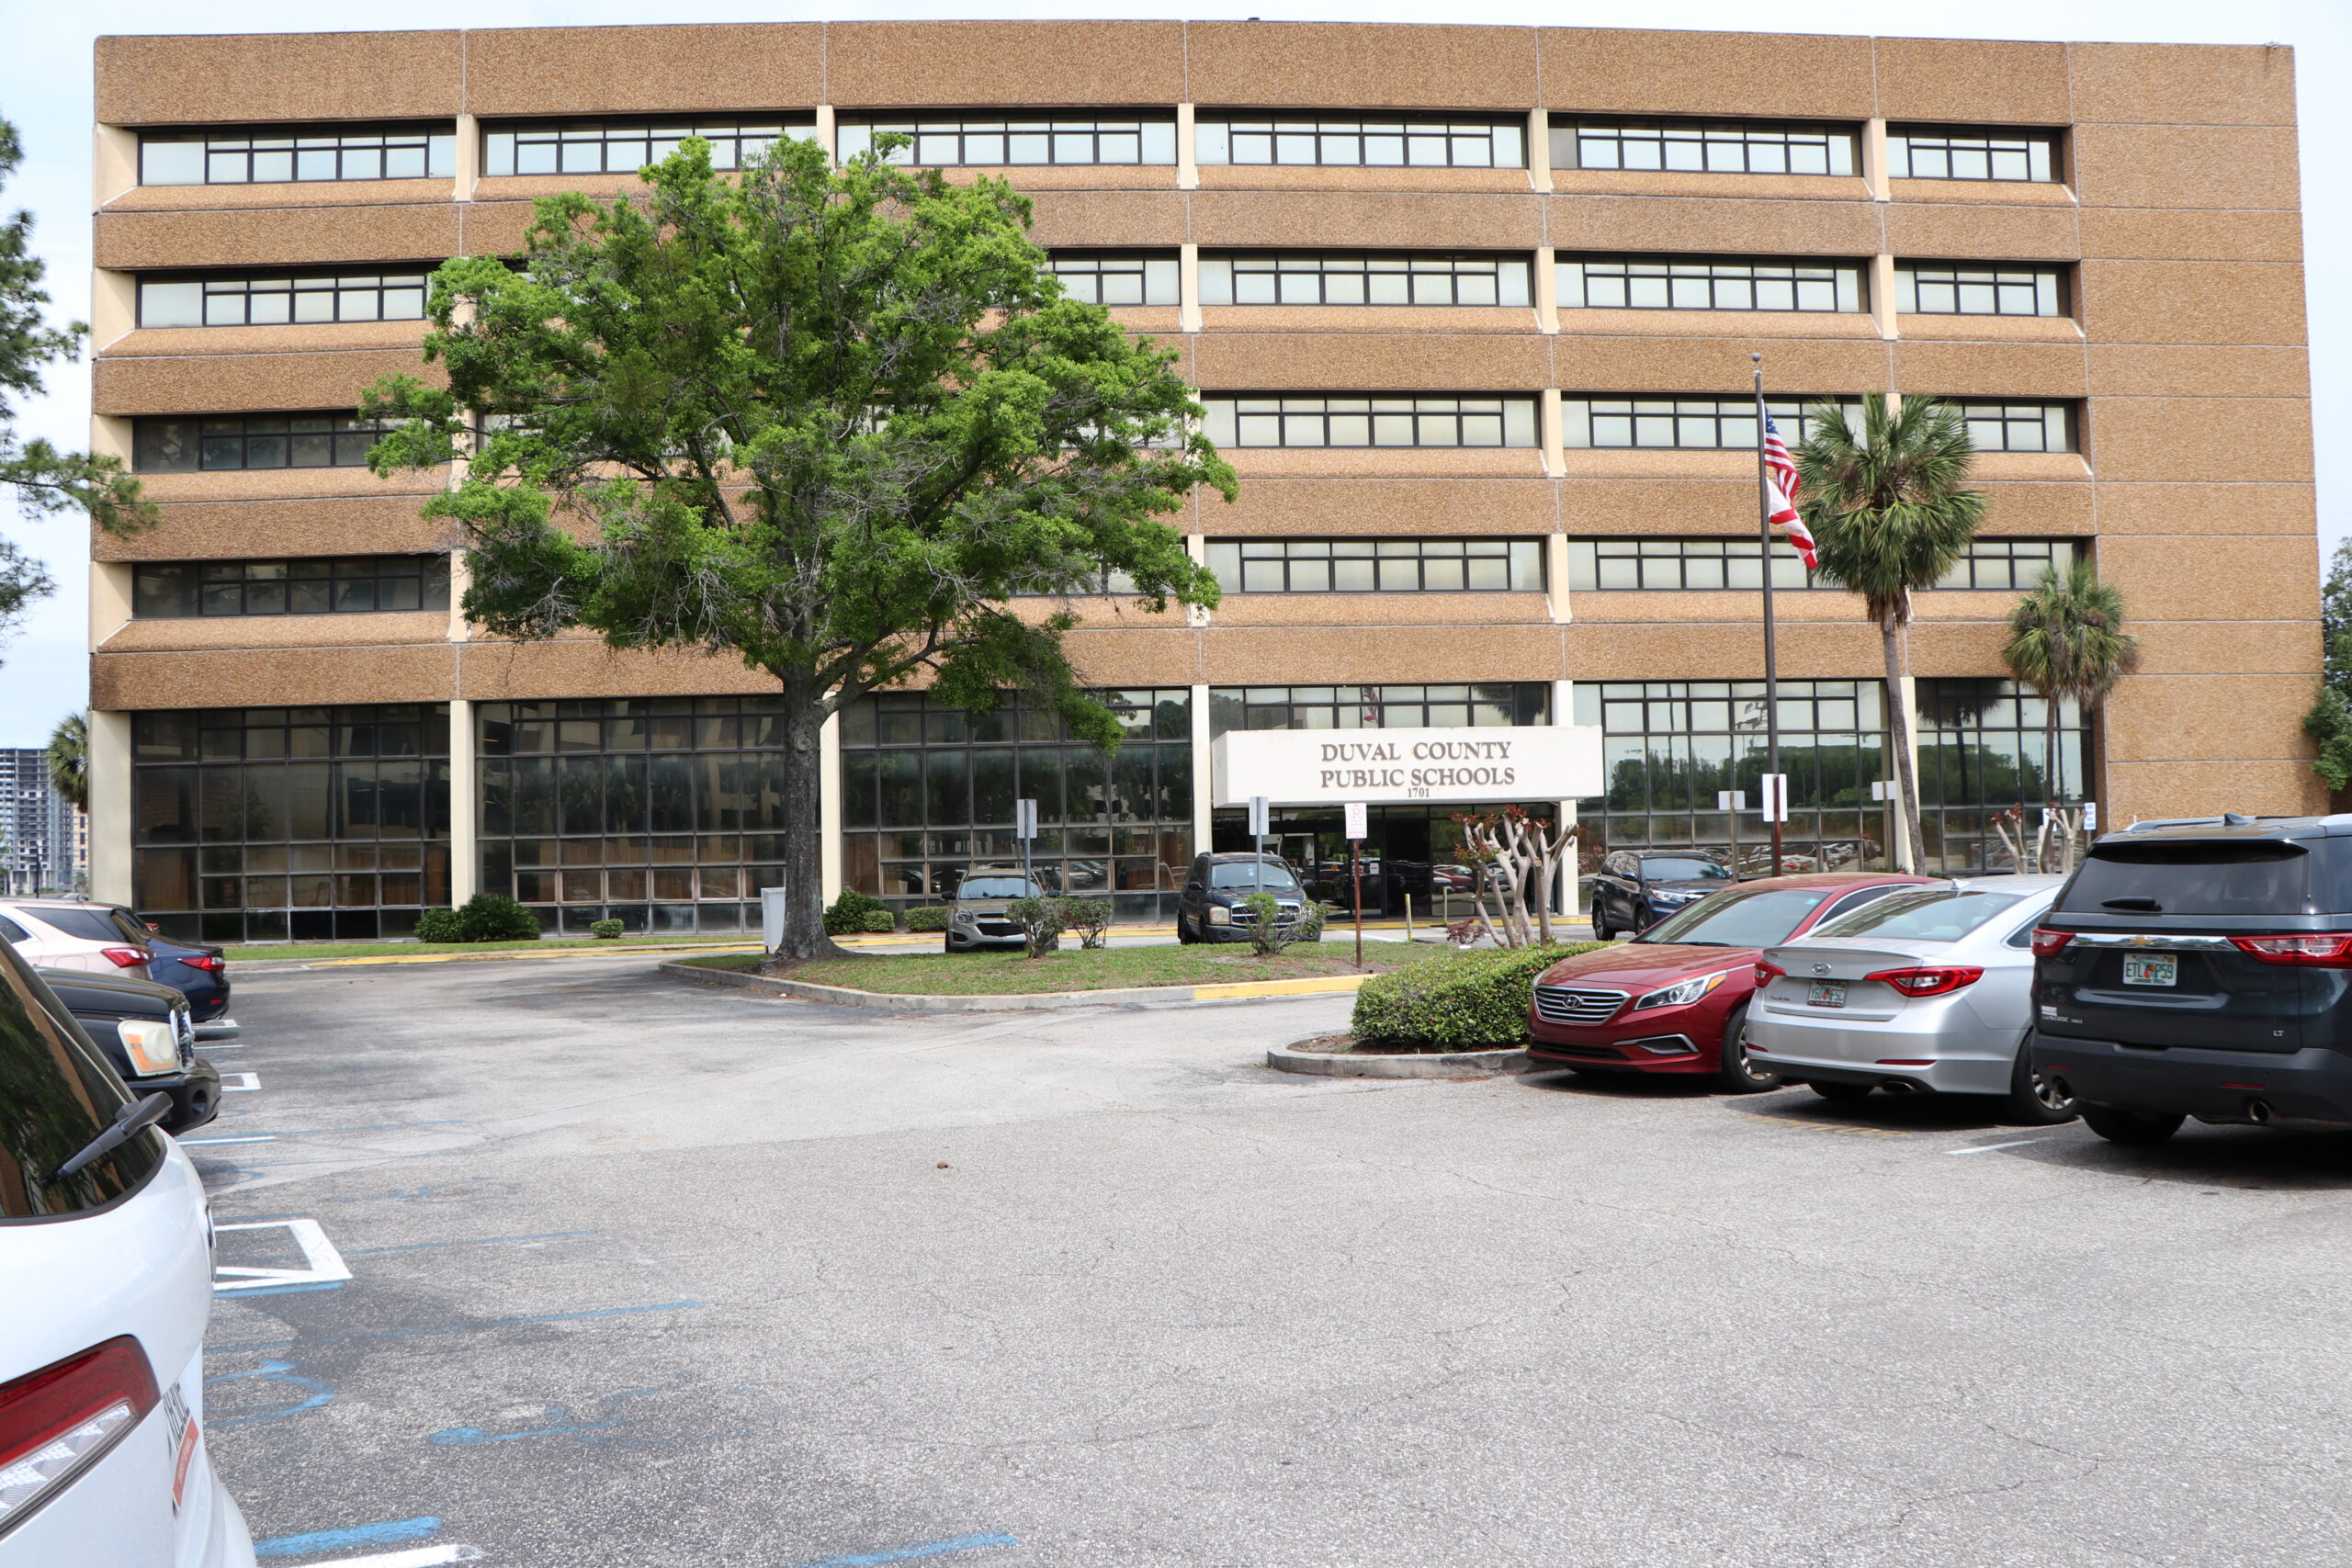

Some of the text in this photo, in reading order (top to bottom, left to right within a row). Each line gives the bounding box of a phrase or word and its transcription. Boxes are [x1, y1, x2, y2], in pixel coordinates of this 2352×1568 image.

[1321, 741, 1512, 762] DUVAL COUNTY
[1320, 767, 1516, 788] PUBLIC SCHOOLS
[1408, 787, 1430, 798] 1701
